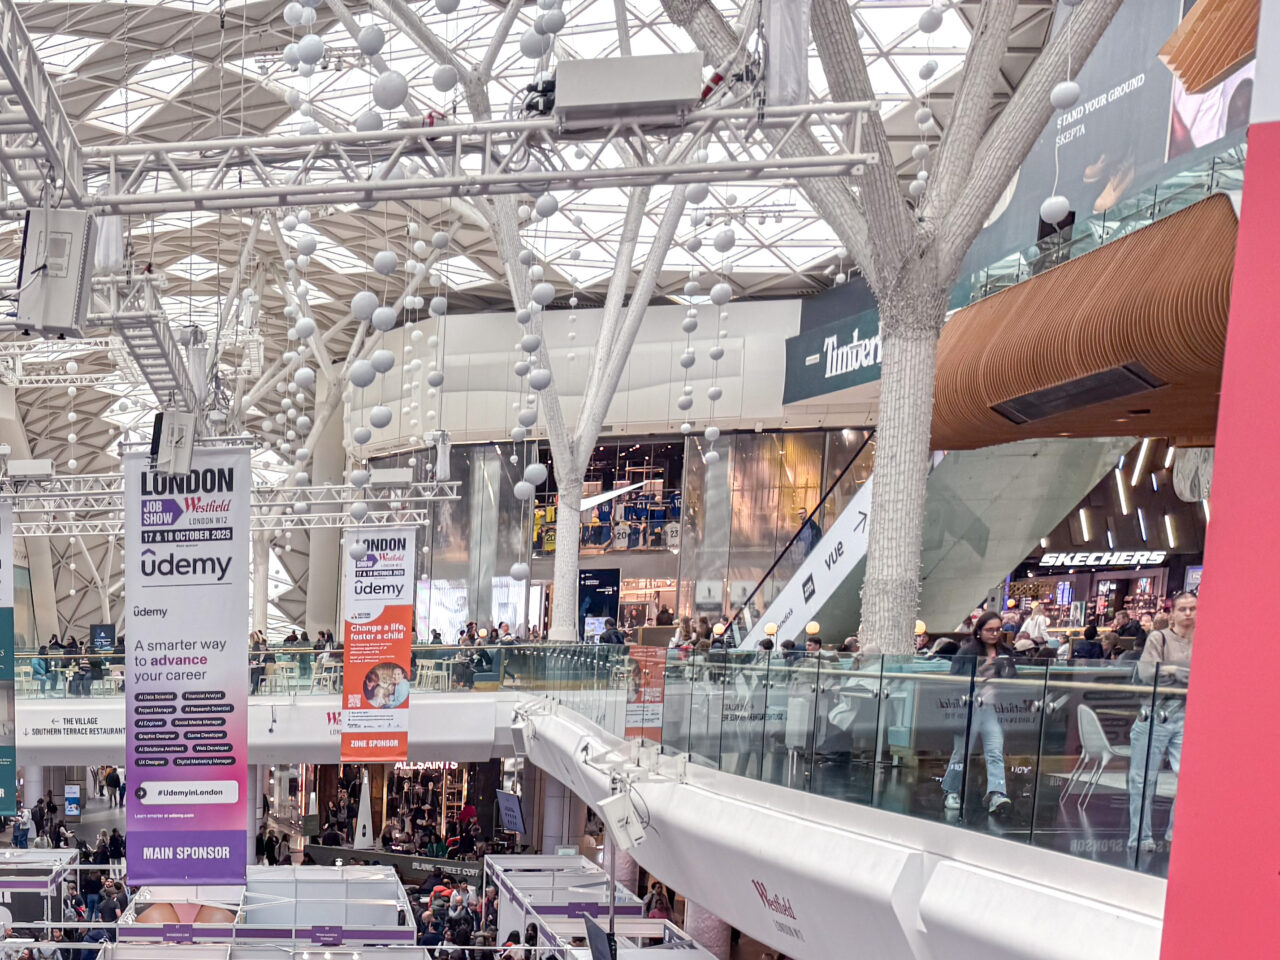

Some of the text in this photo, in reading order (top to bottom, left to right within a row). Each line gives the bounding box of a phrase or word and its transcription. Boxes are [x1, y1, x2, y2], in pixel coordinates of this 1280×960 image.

[1057, 74, 1144, 128] STAND YOUR GROUND
[1056, 124, 1085, 147] SKEPTA
[141, 468, 234, 496] LONDON
[144, 501, 162, 513] JOB
[184, 497, 232, 513] Westfield
[144, 513, 173, 524] SHOW
[189, 517, 214, 525] LONDON
[144, 530, 230, 541] 17 OCTOBER 2025
[824, 540, 844, 571] vue
[1039, 550, 1166, 567] SKECHERS
[350, 623, 406, 632] Change life,
[134, 640, 226, 652] A smarter way
[135, 655, 208, 666] to advance
[134, 671, 207, 684] your career
[394, 761, 458, 770] ALLSAINTS
[143, 846, 230, 859] MAIN SPONSOR
